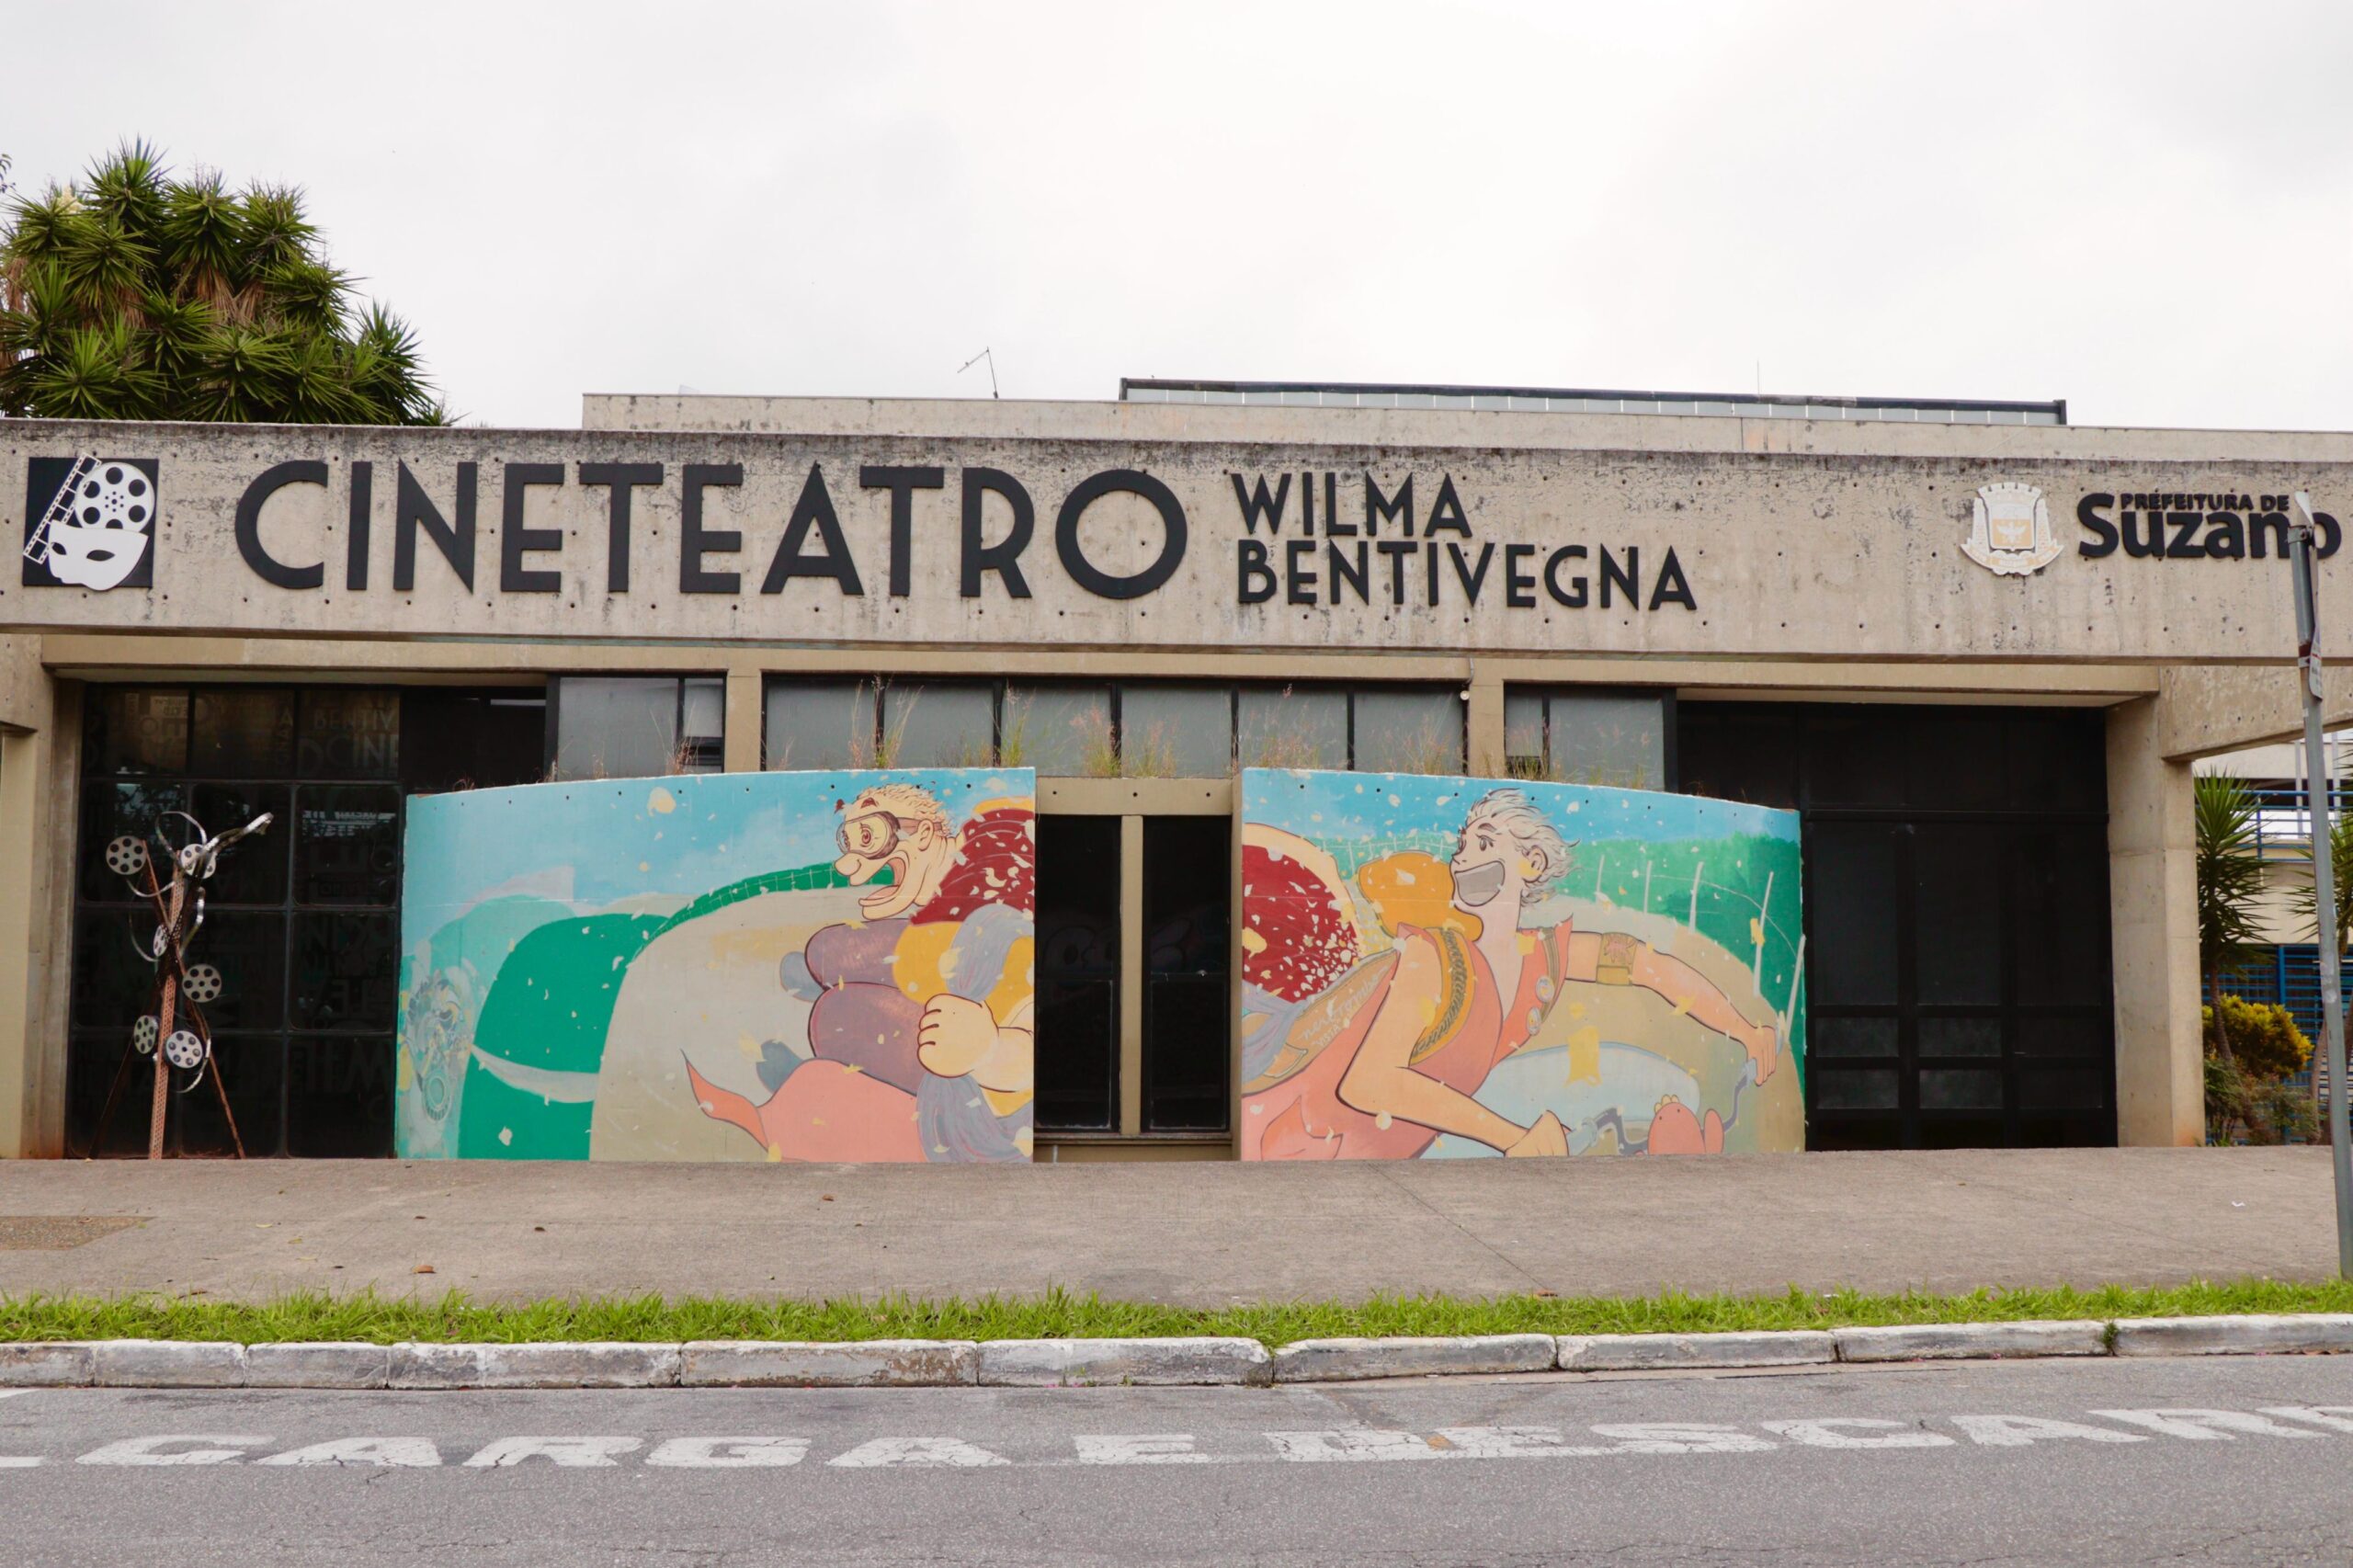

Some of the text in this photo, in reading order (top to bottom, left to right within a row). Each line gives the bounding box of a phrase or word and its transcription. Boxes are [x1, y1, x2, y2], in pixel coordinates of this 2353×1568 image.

[235, 457, 1188, 600] CINETEATRO
[1231, 471, 1472, 537] WILMA
[2076, 493, 2342, 559] Suzano
[2120, 493, 2290, 511] PREFEITURA DE
[1238, 539, 1698, 610] BENTIVEGNA
[74, 1434, 1012, 1468] CARGA
[1074, 1433, 1210, 1465] E
